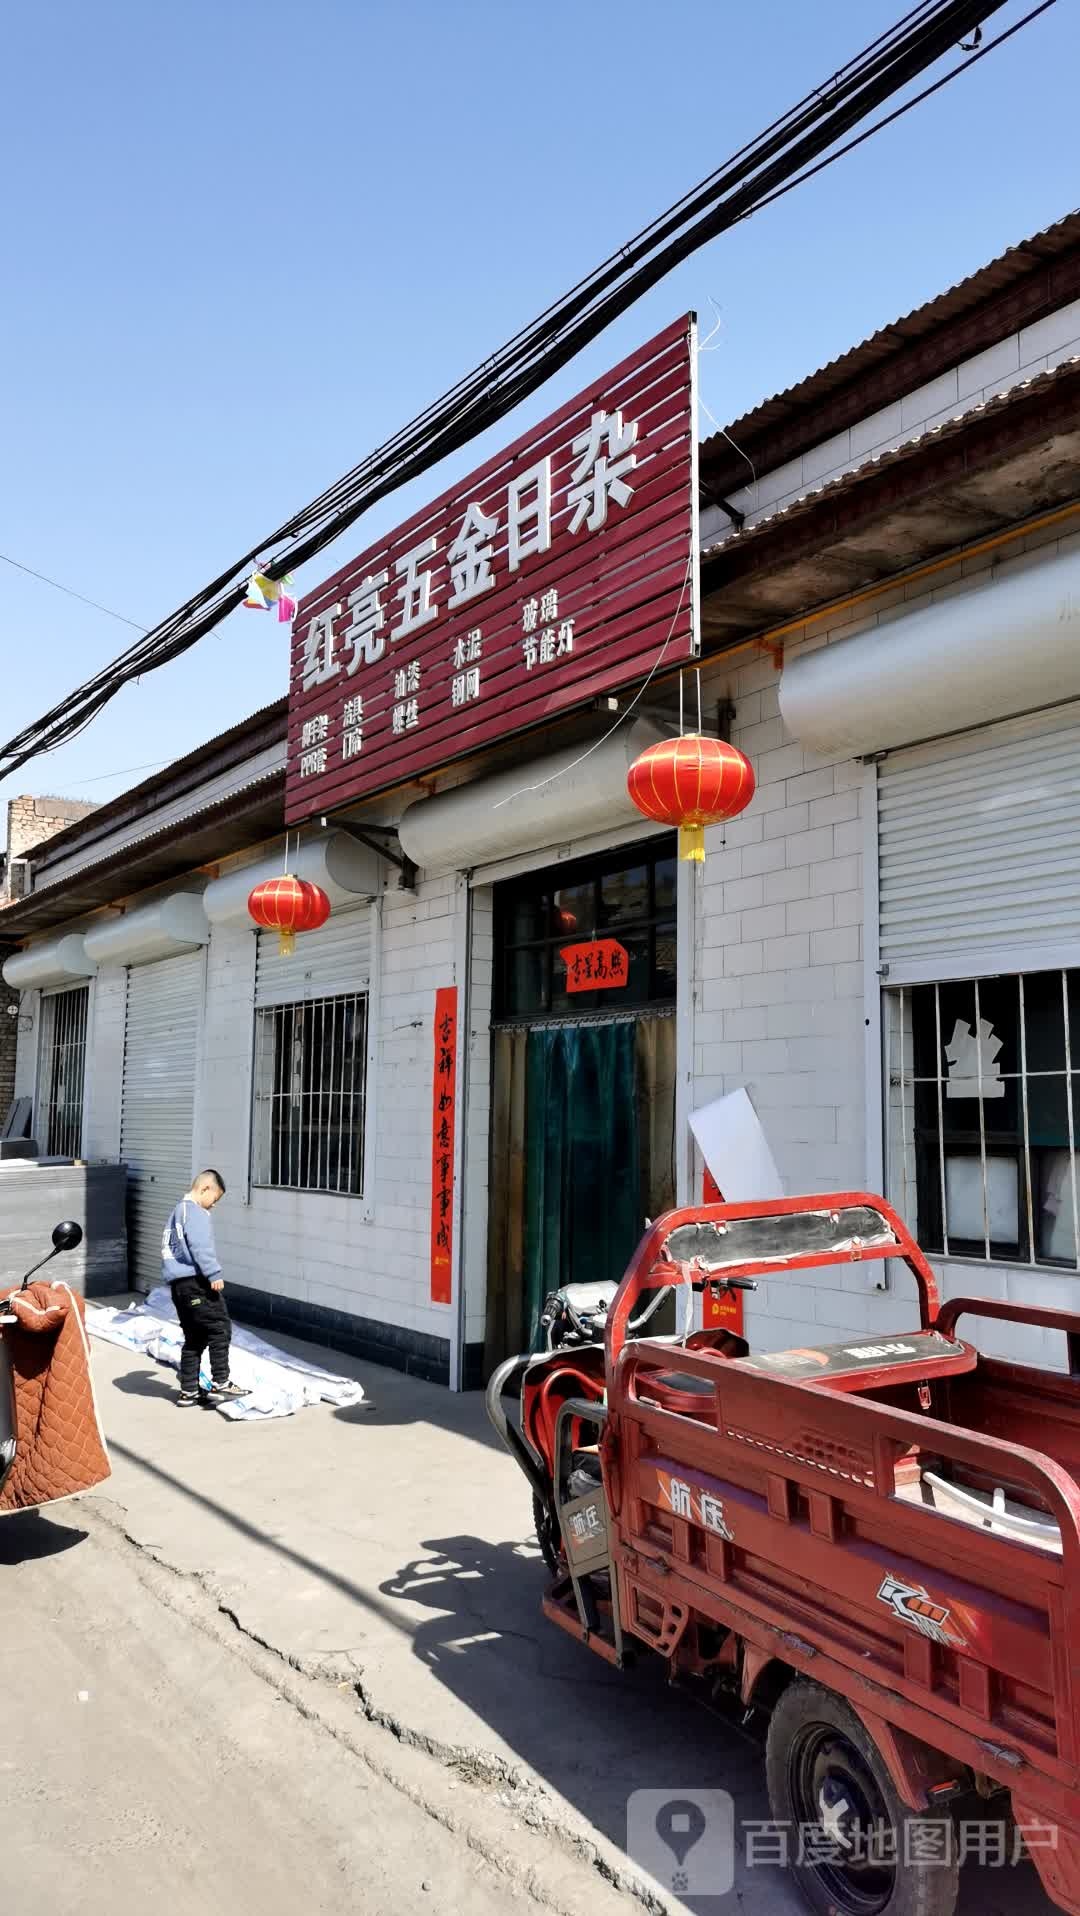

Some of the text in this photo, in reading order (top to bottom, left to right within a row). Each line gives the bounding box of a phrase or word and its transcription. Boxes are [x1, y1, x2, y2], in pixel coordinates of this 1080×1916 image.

[302, 409, 639, 692] 红亮五金日杂
[301, 747, 328, 778] PPR管
[393, 699, 419, 735] 螺丝
[452, 667, 480, 707] 钢网
[523, 619, 575, 671] 节能灯
[343, 695, 364, 727] 洁具
[394, 660, 420, 699] 油漆
[453, 629, 482, 669] 水泥
[522, 588, 560, 633] 玻璃
[571, 948, 624, 984] 吉星高照
[436, 1012, 453, 1255] 吉祥如意事事成
